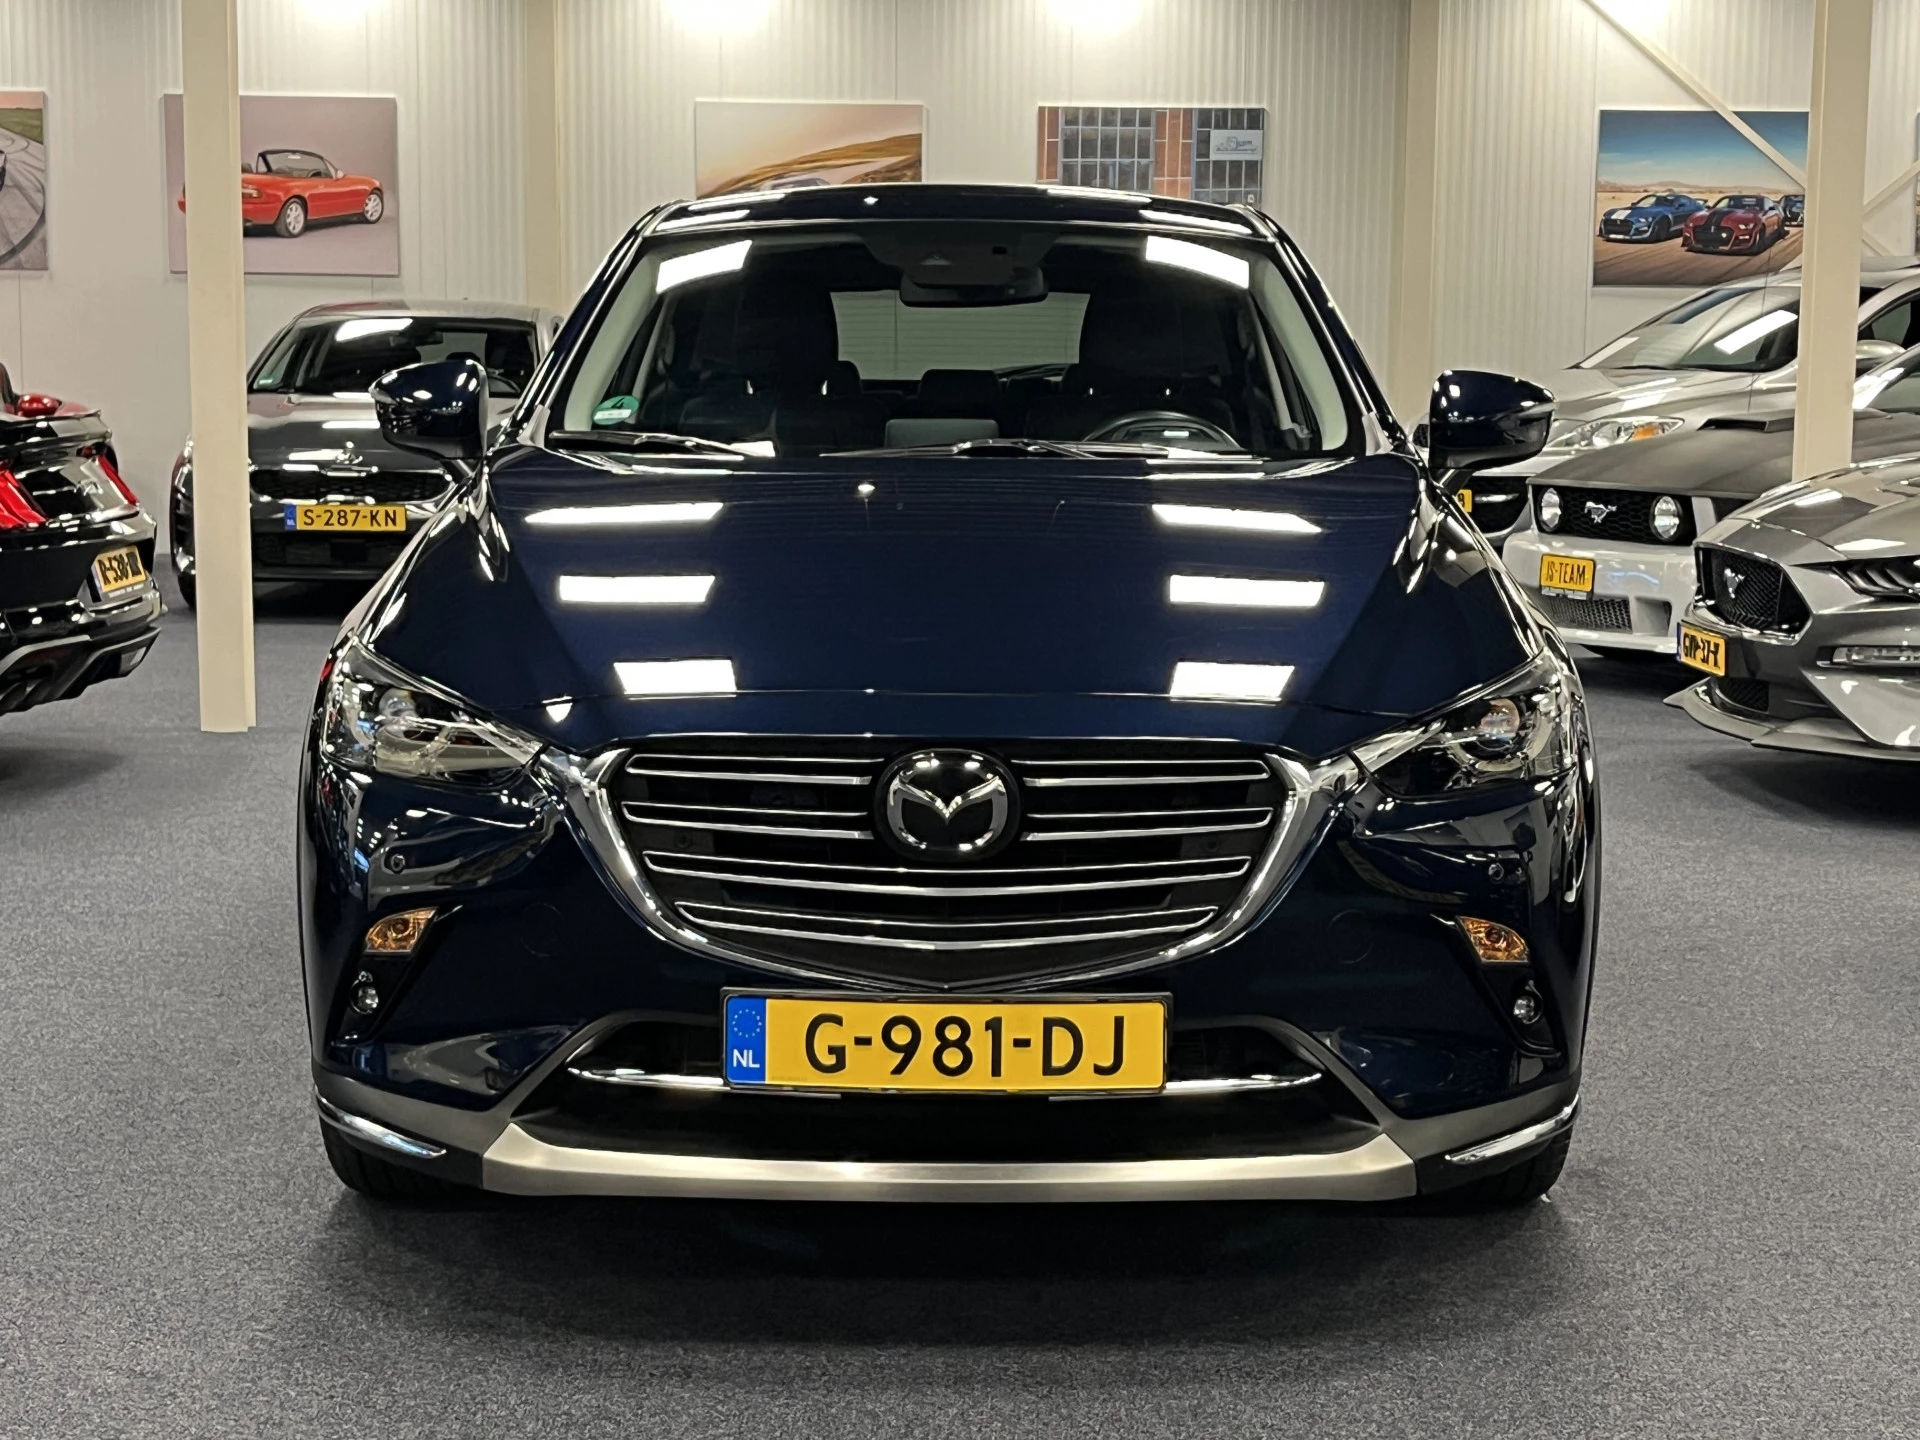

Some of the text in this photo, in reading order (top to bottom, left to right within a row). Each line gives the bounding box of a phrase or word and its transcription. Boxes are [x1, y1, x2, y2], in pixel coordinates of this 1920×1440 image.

[303, 508, 398, 528] S-287-KN
[805, 1012, 1125, 1078] G-981-DJ
[732, 1049, 761, 1069] NL
